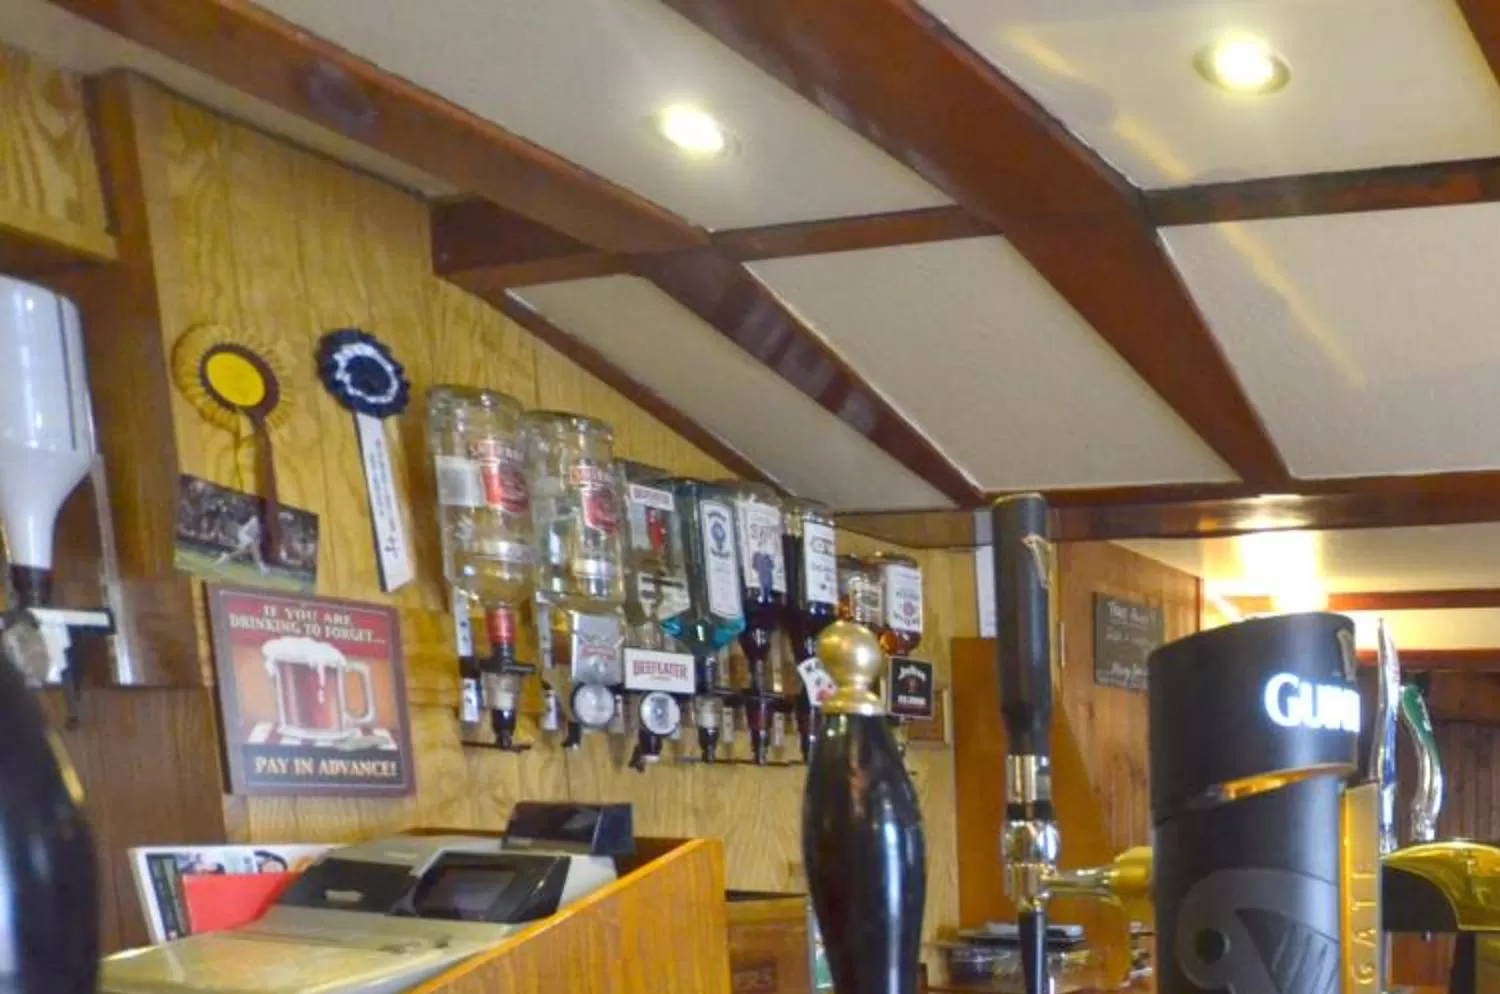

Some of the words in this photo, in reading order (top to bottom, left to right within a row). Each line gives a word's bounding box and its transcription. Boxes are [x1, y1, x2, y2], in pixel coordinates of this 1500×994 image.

[229, 612, 301, 634] DRINKING
[304, 623, 321, 637] TO
[263, 605, 277, 617] IF
[284, 607, 318, 622] YOU
[323, 612, 353, 626] ARE
[255, 756, 288, 774] PAY
[294, 757, 314, 775] IN
[318, 758, 397, 777] ADVANCE!
